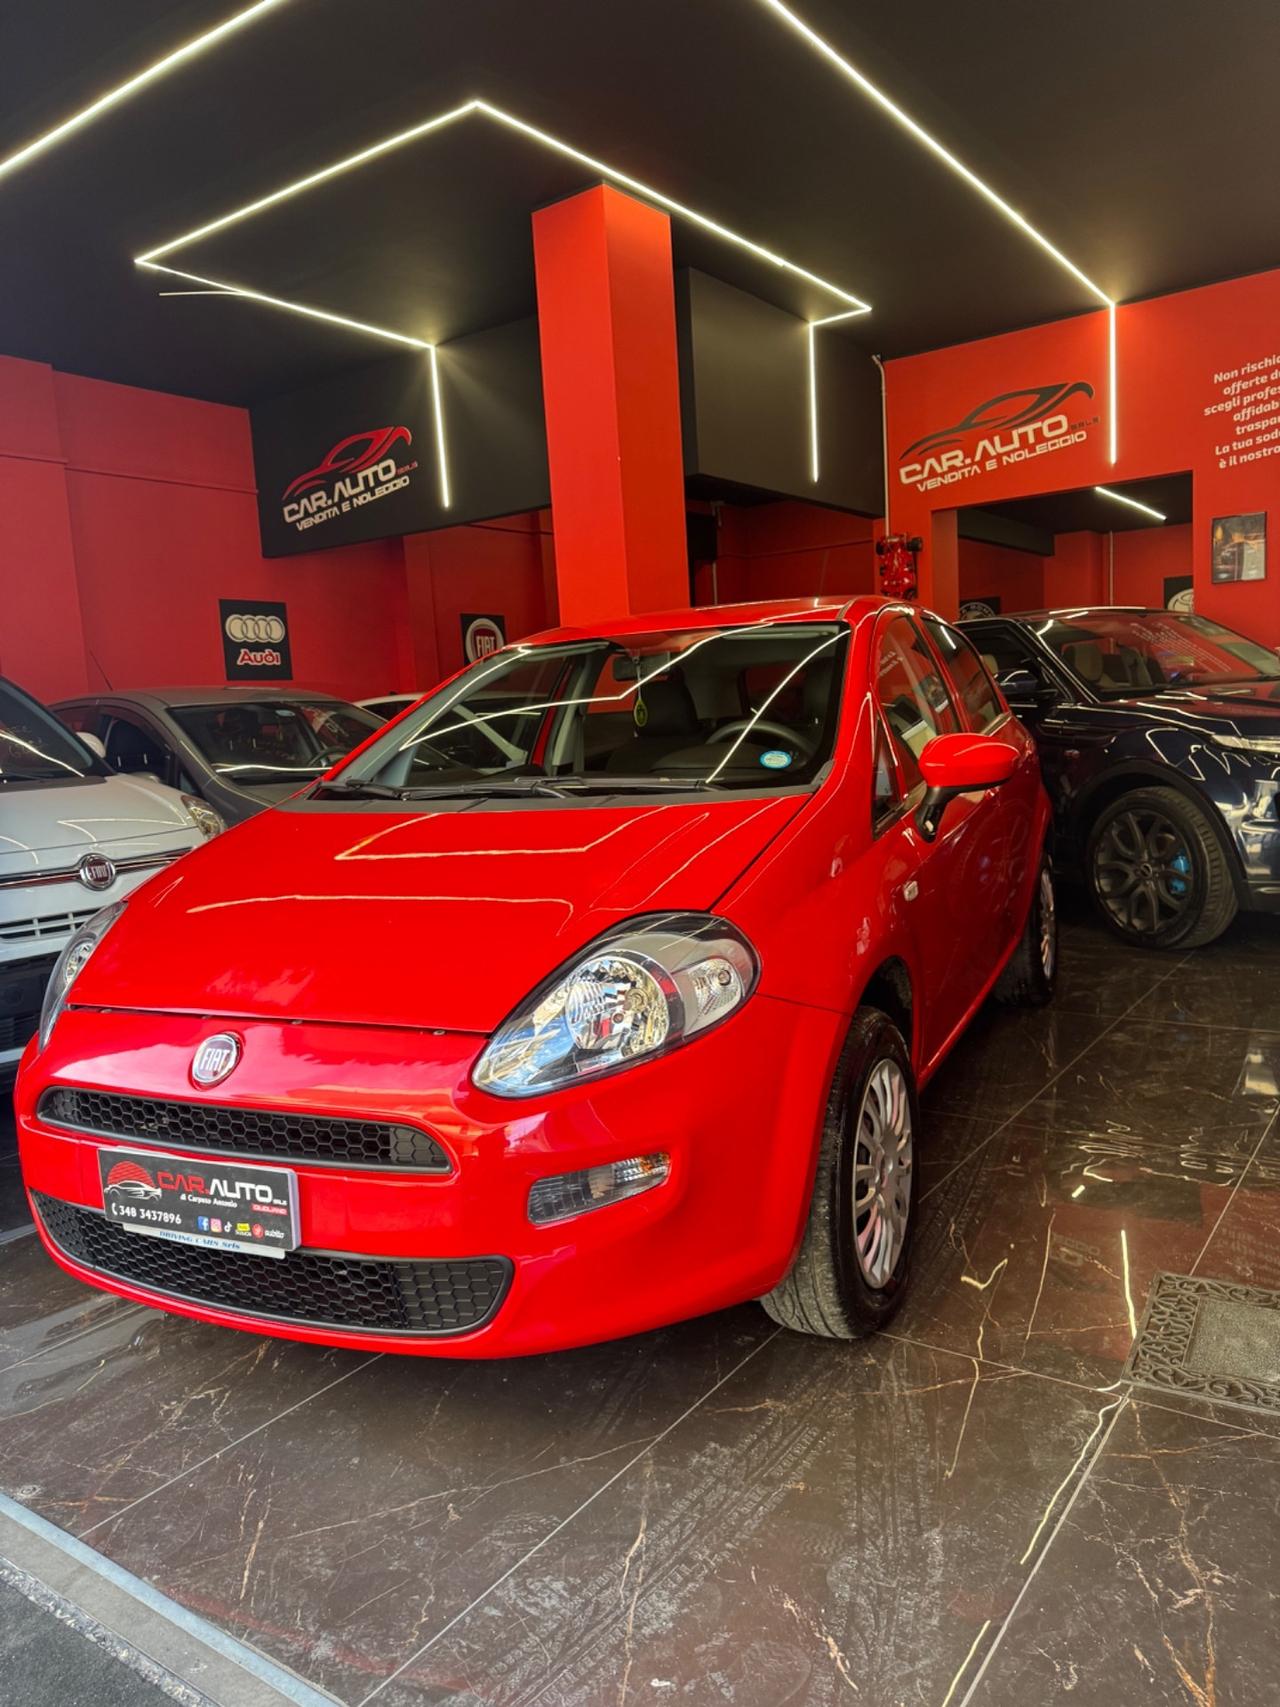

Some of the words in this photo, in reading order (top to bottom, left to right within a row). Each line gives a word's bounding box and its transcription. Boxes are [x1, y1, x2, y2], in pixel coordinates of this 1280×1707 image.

[1214, 370, 1238, 384] Non
[1223, 376, 1268, 396] offerte
[1270, 368, 1280, 381] d
[1204, 395, 1240, 416] scegli
[899, 414, 1068, 485] CAR.AUTO
[1215, 445, 1230, 456] La
[1231, 438, 1253, 451] tua
[1255, 428, 1280, 445] sod
[916, 465, 981, 492] VENDITA
[986, 459, 998, 471] E
[1002, 430, 1087, 466] NOLEGGIO
[1219, 458, 1227, 469] è
[1229, 455, 1238, 467] il
[282, 458, 396, 524] CAR.AUTO
[296, 508, 340, 532] VENDITA
[342, 501, 351, 512] E
[353, 475, 410, 508] NOLEGGIO
[237, 648, 281, 666] Audi
[199, 1047, 231, 1071] FIAT
[119, 1205, 137, 1218] 348
[139, 1208, 182, 1225] 3437896
[159, 1230, 193, 1243] DRIVING
